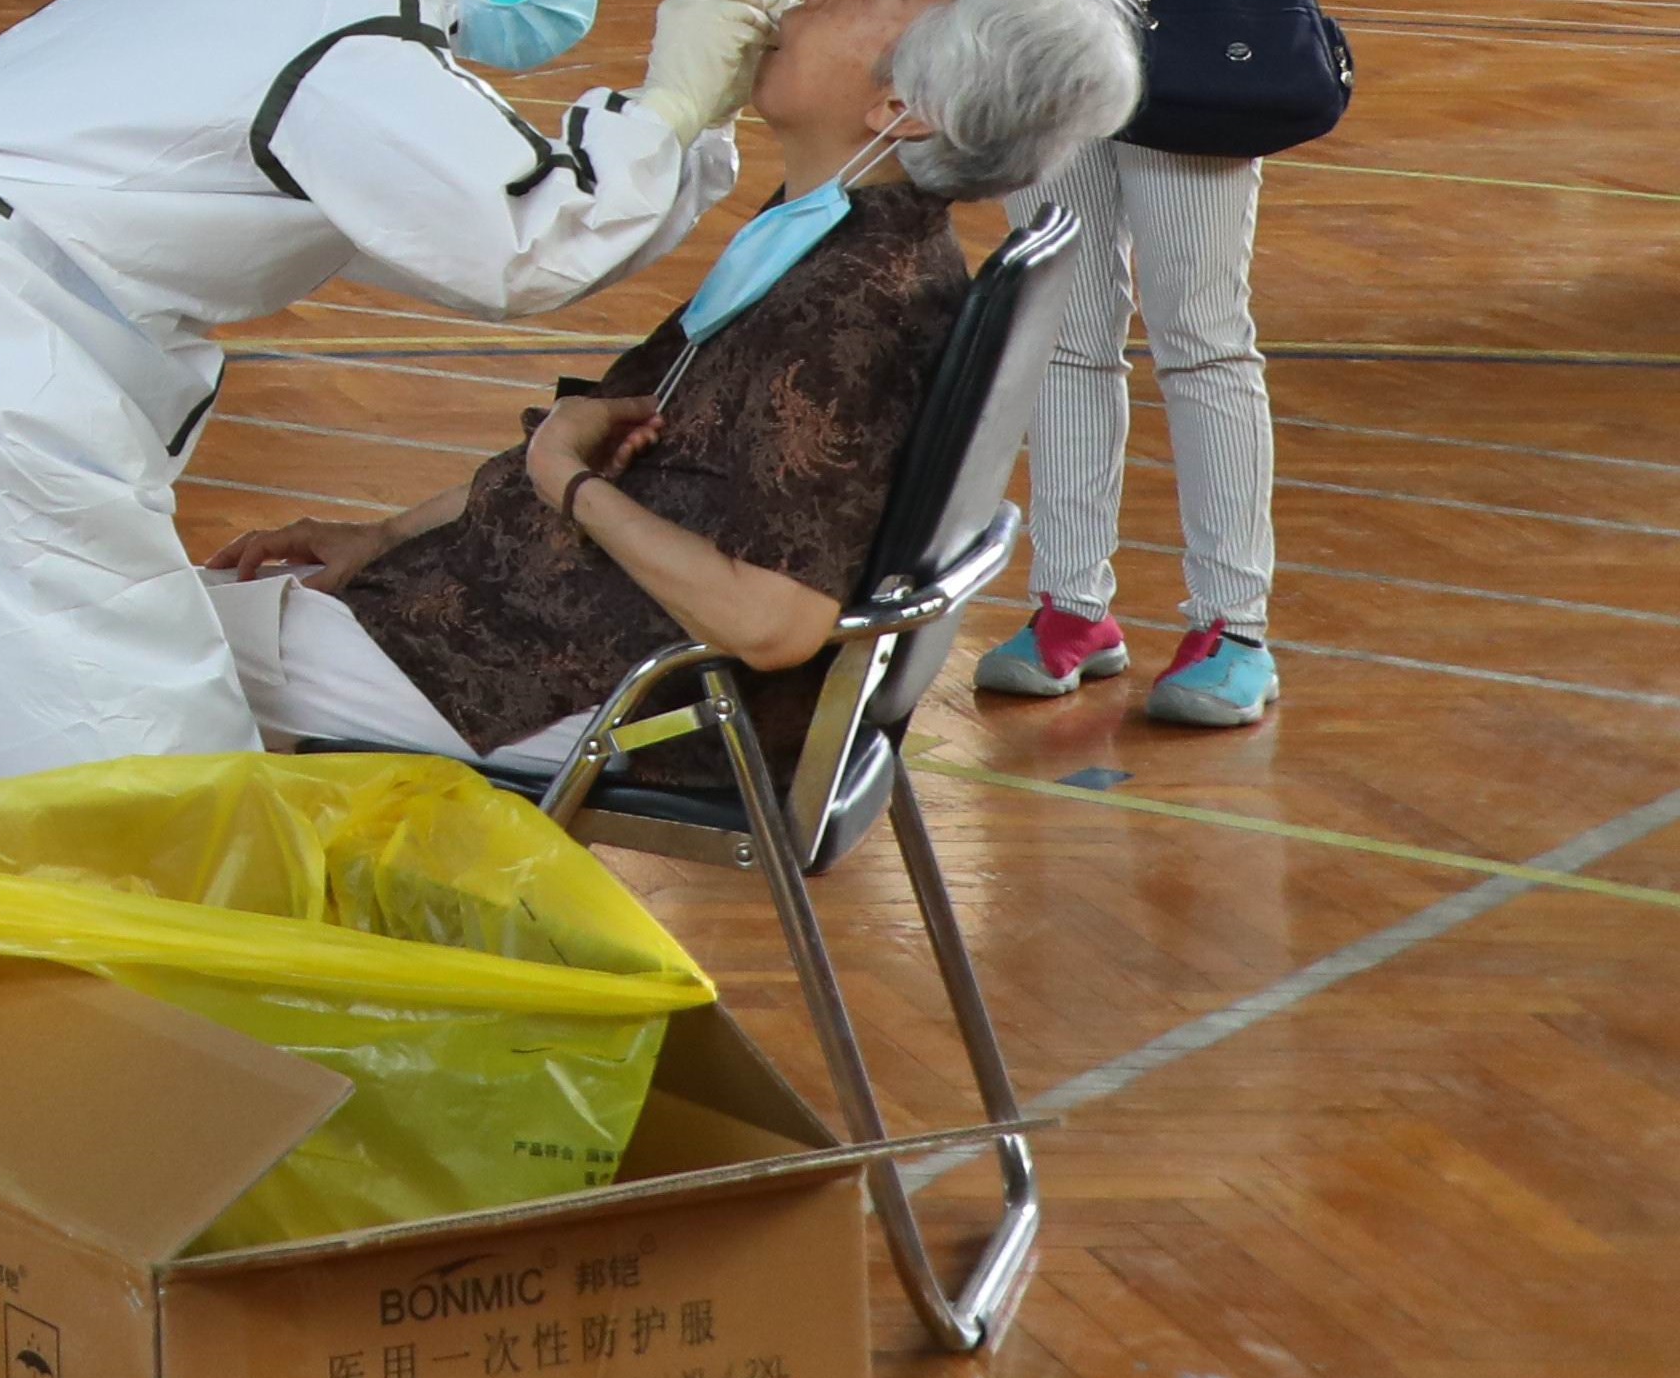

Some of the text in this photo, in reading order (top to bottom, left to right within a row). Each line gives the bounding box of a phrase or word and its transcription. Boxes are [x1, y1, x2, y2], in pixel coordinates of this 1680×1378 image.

[379, 1267, 547, 1326] BONMIC
[328, 1299, 715, 1378] 医用一次性防护服
